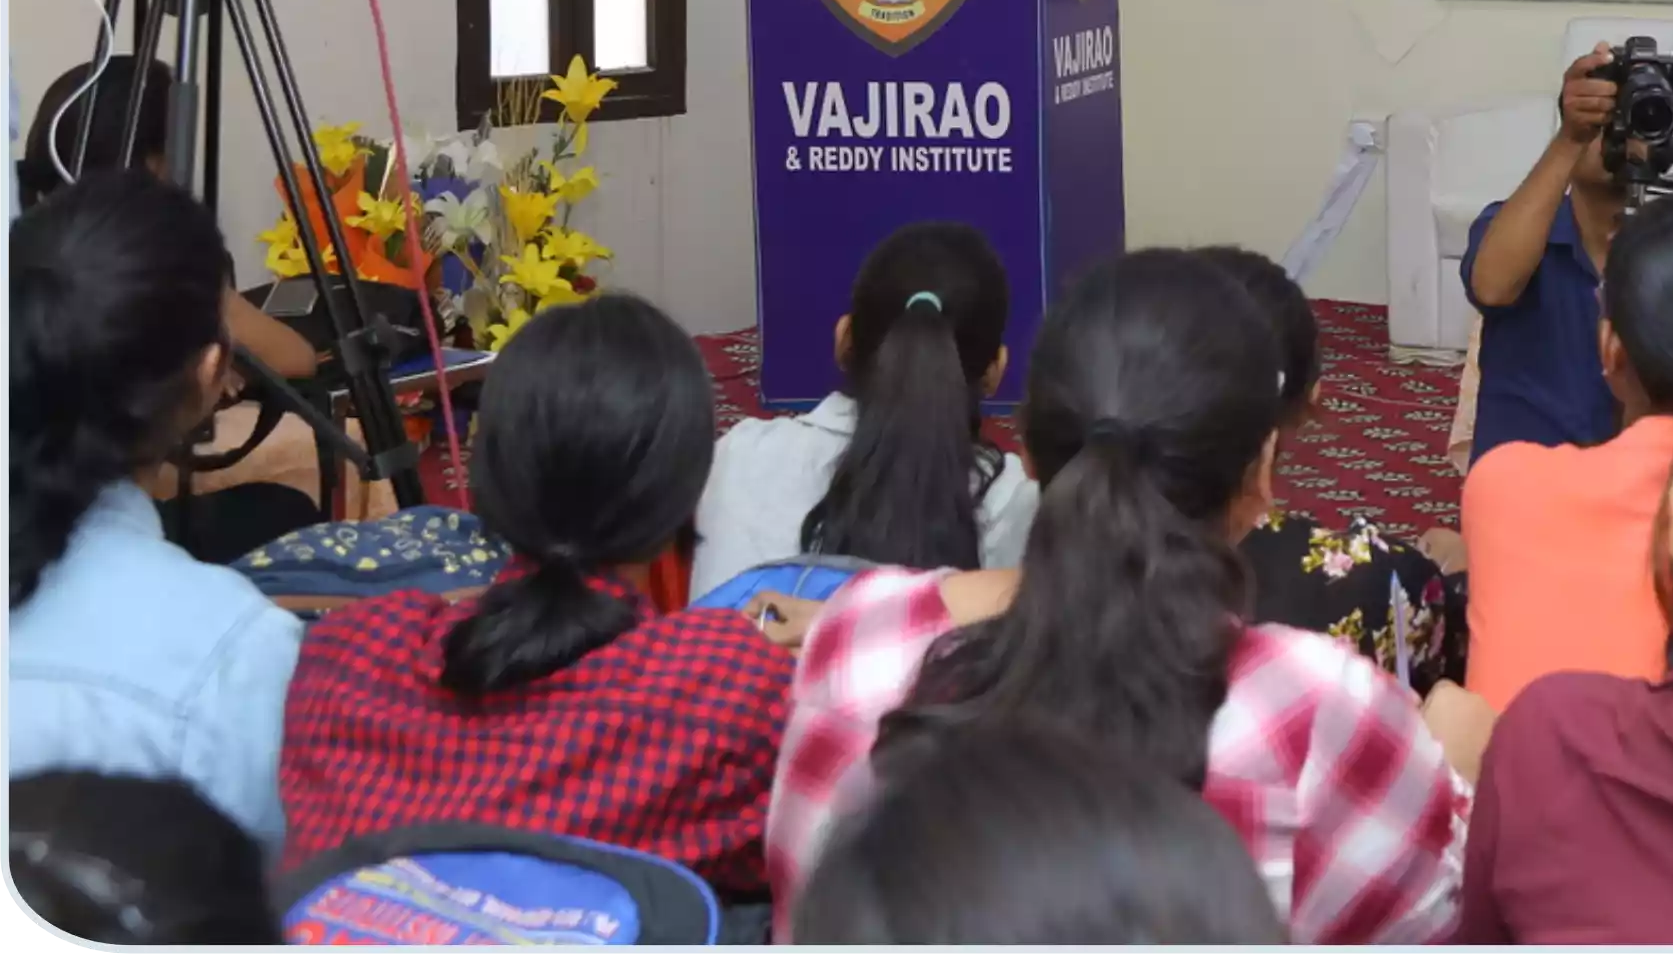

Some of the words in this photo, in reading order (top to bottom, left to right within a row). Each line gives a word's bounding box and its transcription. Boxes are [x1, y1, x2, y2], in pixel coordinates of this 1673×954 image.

[1053, 25, 1112, 78] VAJIRAO
[782, 80, 1011, 139] VAJIRAO
[786, 146, 801, 171] &
[809, 147, 884, 171] REDDY
[891, 147, 1013, 172] INSTITUTE
